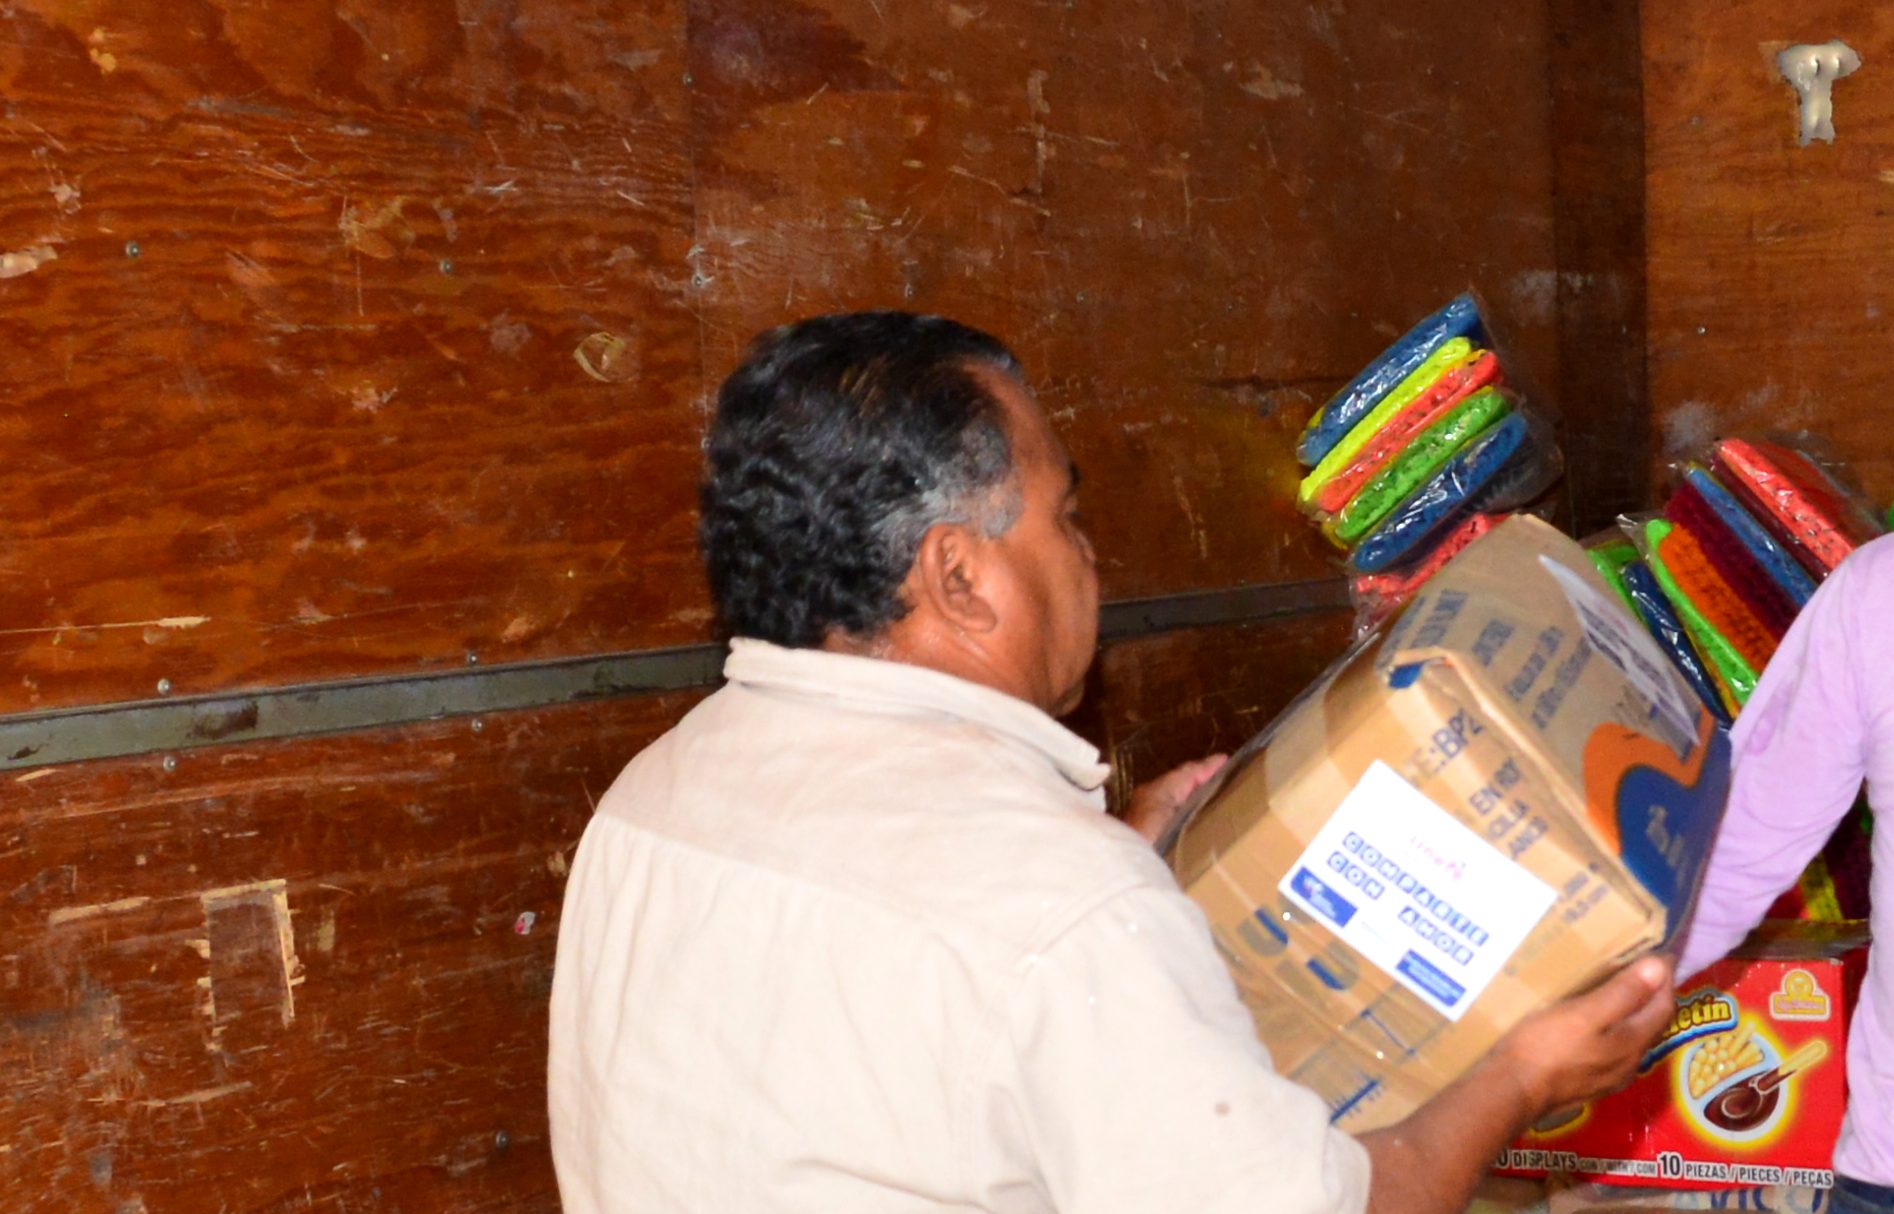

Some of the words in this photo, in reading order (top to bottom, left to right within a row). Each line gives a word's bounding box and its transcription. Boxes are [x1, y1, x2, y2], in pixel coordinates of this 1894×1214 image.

[1512, 1151, 1578, 1171] DISPLAYS
[1659, 1154, 1682, 1178] 10
[1685, 1163, 1727, 1180] PIEZAS
[1738, 1166, 1781, 1183] PIECES
